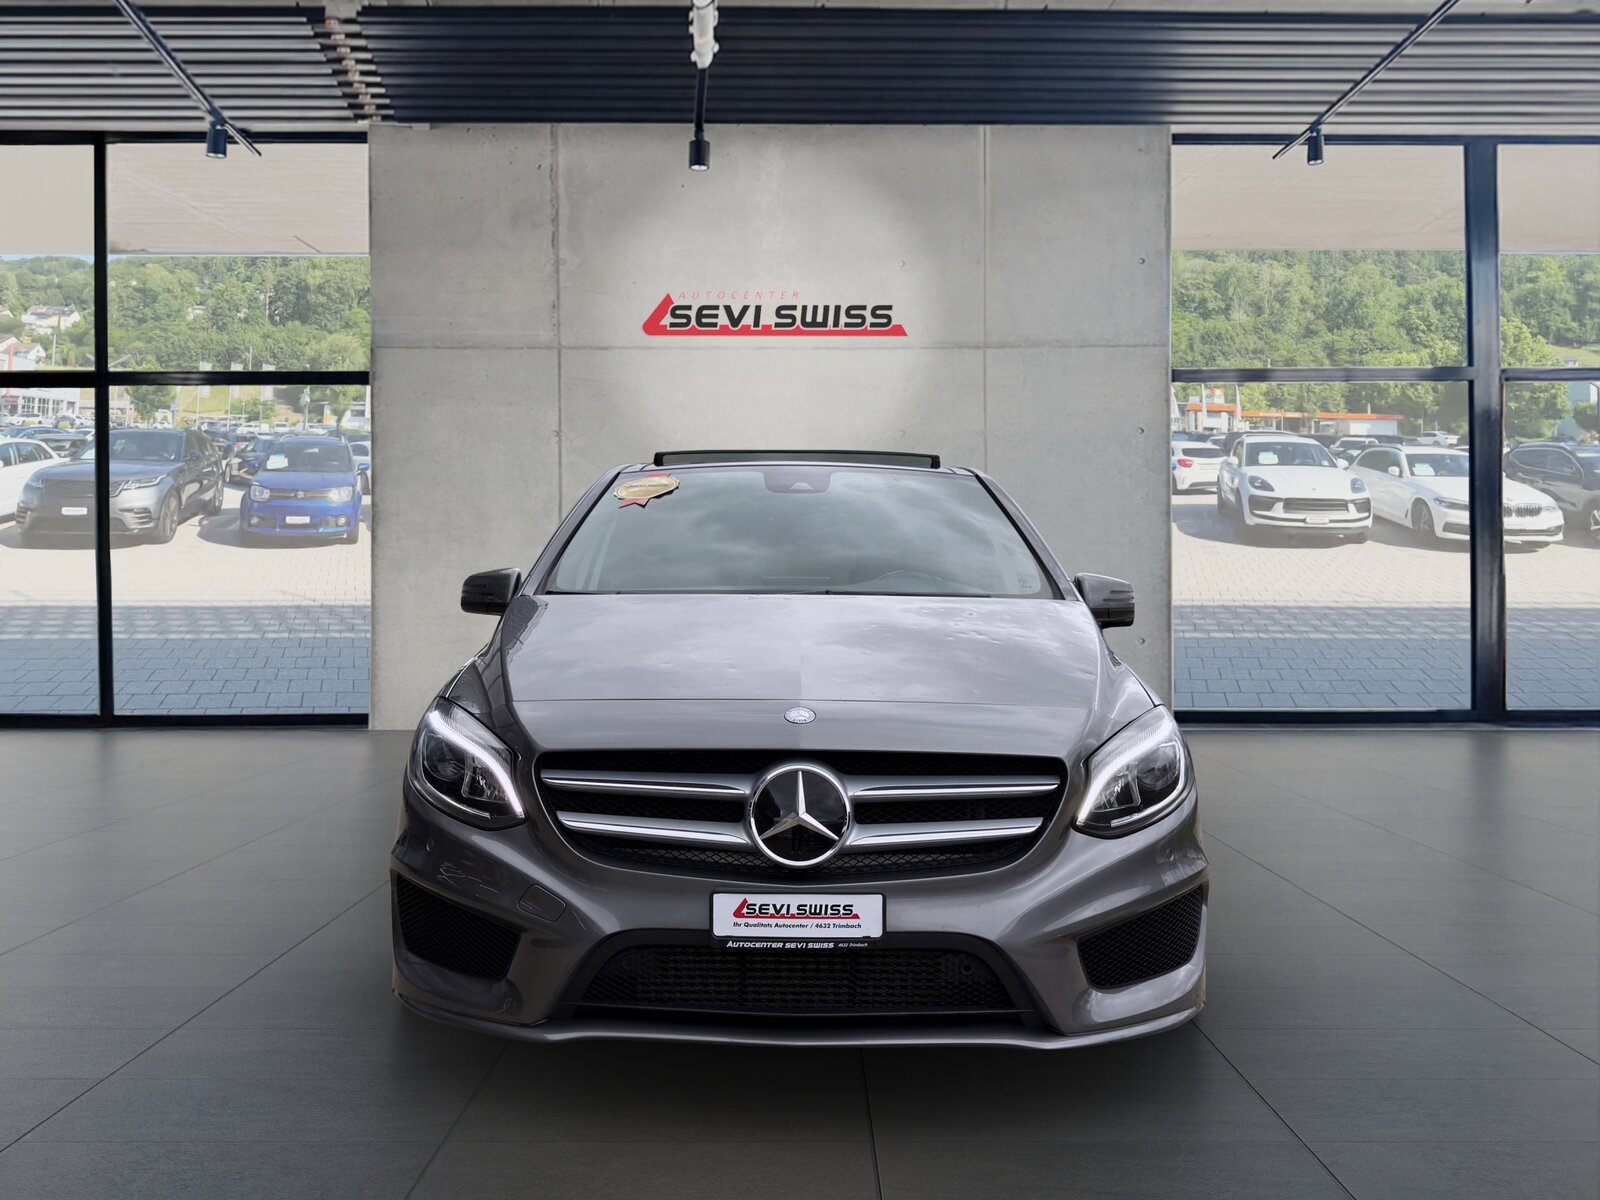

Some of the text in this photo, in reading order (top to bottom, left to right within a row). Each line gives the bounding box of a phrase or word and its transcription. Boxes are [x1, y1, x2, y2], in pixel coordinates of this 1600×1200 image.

[678, 290, 800, 300] AUTOCENTER
[668, 304, 894, 329] SEVI SWISS
[745, 903, 854, 916] SEVI SWISS
